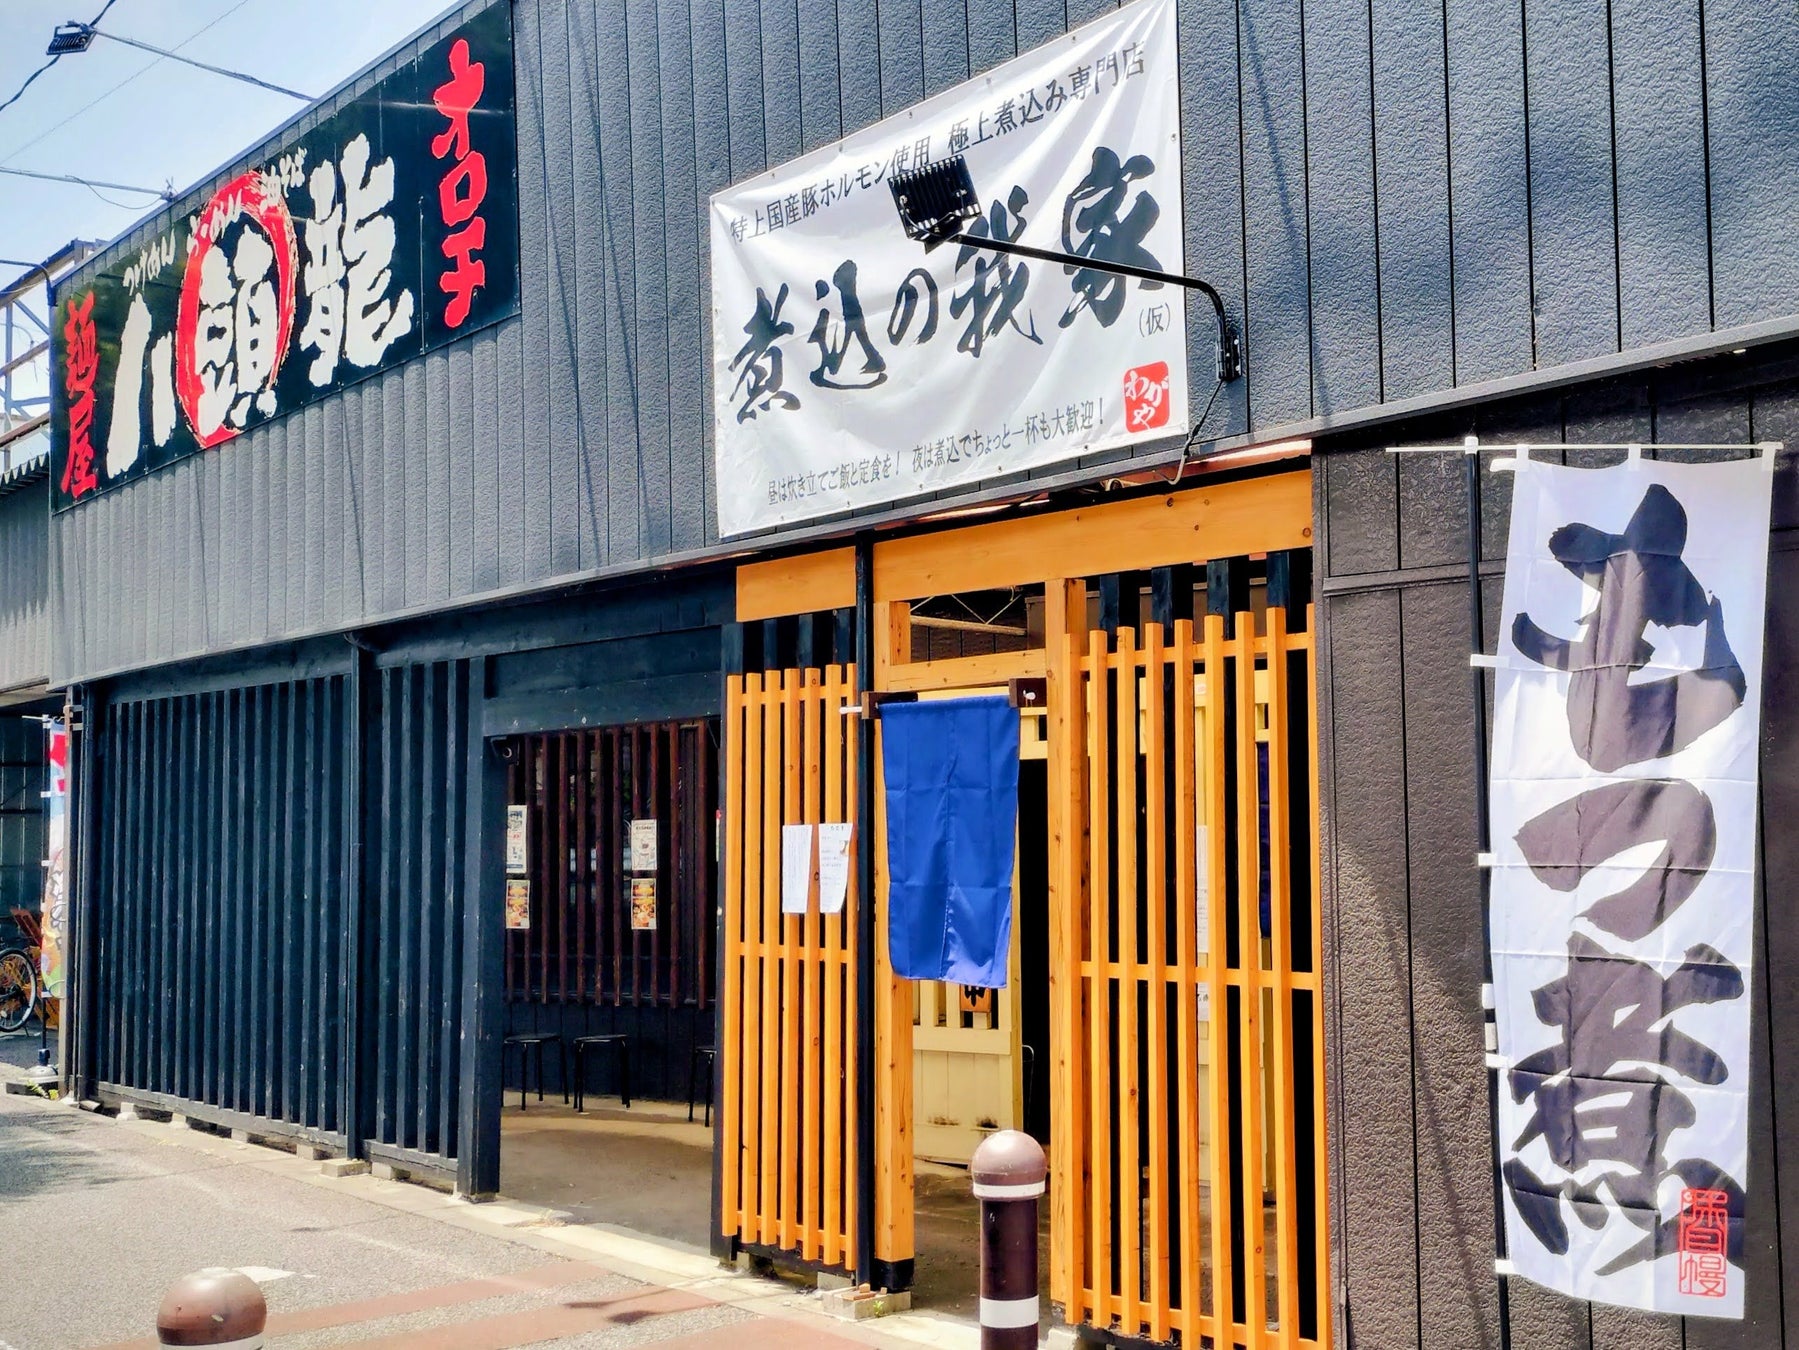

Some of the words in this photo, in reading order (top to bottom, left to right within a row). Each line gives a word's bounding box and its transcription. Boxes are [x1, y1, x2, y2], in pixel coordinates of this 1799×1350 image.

[432, 38, 488, 330] オロチ
[729, 134, 932, 246] 特上国産豚ホルモン使用
[946, 40, 1147, 156] 極上煮込み専門店
[122, 227, 176, 297] つけめん
[727, 145, 1165, 424] 煮込の我家
[1138, 301, 1171, 338] (仮)
[60, 290, 100, 498] 麺屋
[1124, 369, 1170, 430] わがや
[1503, 483, 1747, 1277] もつ煮
